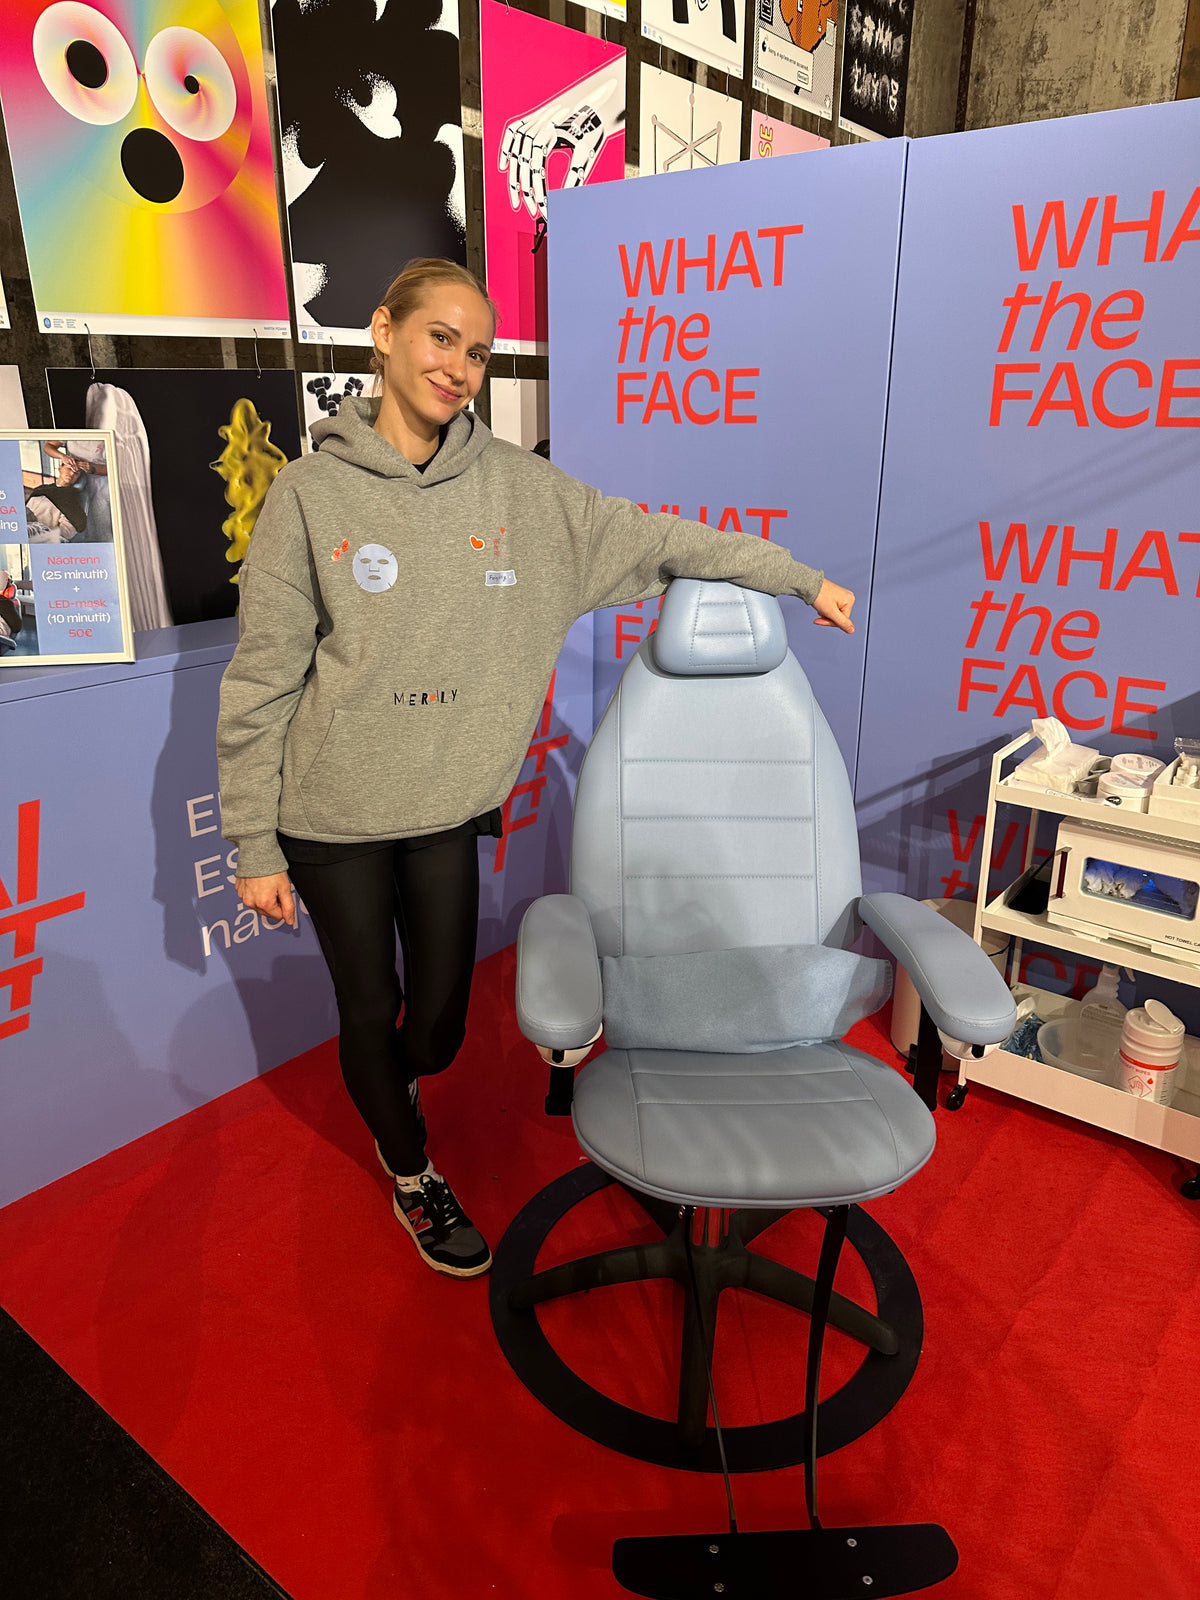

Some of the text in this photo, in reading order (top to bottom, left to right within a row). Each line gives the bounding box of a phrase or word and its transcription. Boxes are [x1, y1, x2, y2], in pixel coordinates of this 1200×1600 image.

[619, 225, 803, 297] WHAT
[618, 306, 709, 363] the
[998, 281, 1144, 352] the
[617, 368, 759, 424] FACE
[990, 359, 1200, 428] FACE
[41, 569, 108, 582] (25 minutit)
[47, 612, 111, 625] (10 minutit)
[48, 599, 107, 609] LED-mask
[966, 591, 1099, 660] the
[68, 629, 93, 638] 50€
[958, 658, 1166, 740] FACE
[1176, 937, 1193, 946] TOWEL
